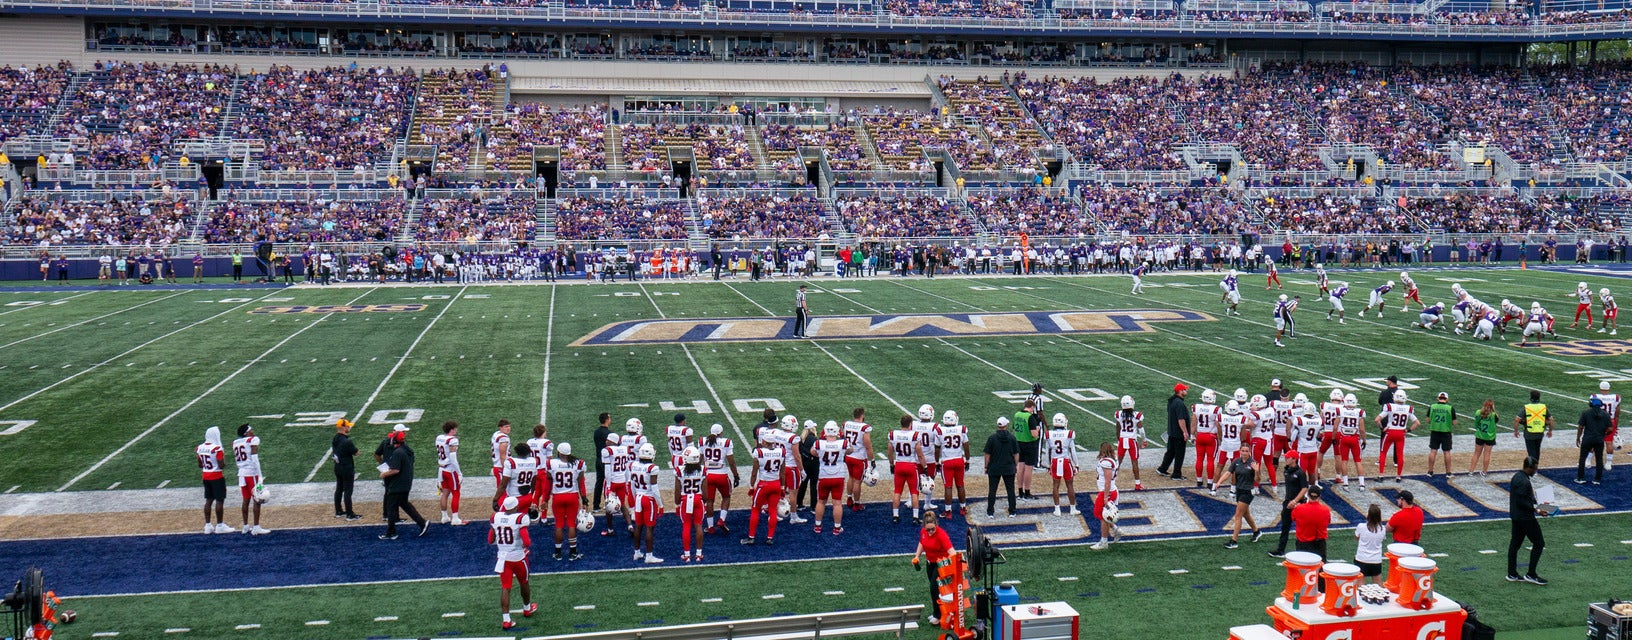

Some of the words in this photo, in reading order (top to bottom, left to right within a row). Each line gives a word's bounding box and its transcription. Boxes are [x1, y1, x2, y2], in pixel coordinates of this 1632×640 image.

[567, 309, 1218, 347] JMU
[992, 387, 1120, 404] 50
[659, 398, 786, 414] 40
[284, 408, 425, 427] 30
[1198, 413, 1210, 428] 41
[1342, 417, 1357, 428] 48
[1391, 413, 1408, 428] 38
[1435, 415, 1446, 423] 24
[1121, 419, 1134, 432] 12
[1223, 424, 1238, 439] 19
[845, 431, 859, 446] 57
[1306, 428, 1316, 441] 9
[669, 436, 682, 451] 39
[895, 442, 912, 458] 40
[943, 435, 961, 450] 33
[1055, 440, 1063, 454] 3
[704, 448, 722, 462] 99
[822, 451, 840, 466] 47
[613, 456, 627, 472] 20
[764, 459, 781, 473] 43
[517, 471, 533, 484] 88
[555, 472, 573, 488] 93
[631, 473, 648, 490] 34
[683, 479, 700, 494] 25
[497, 526, 514, 545] 10
[1304, 570, 1317, 585] G
[1418, 575, 1431, 590] G
[1341, 582, 1354, 597] G
[957, 583, 965, 628] GATORADE
